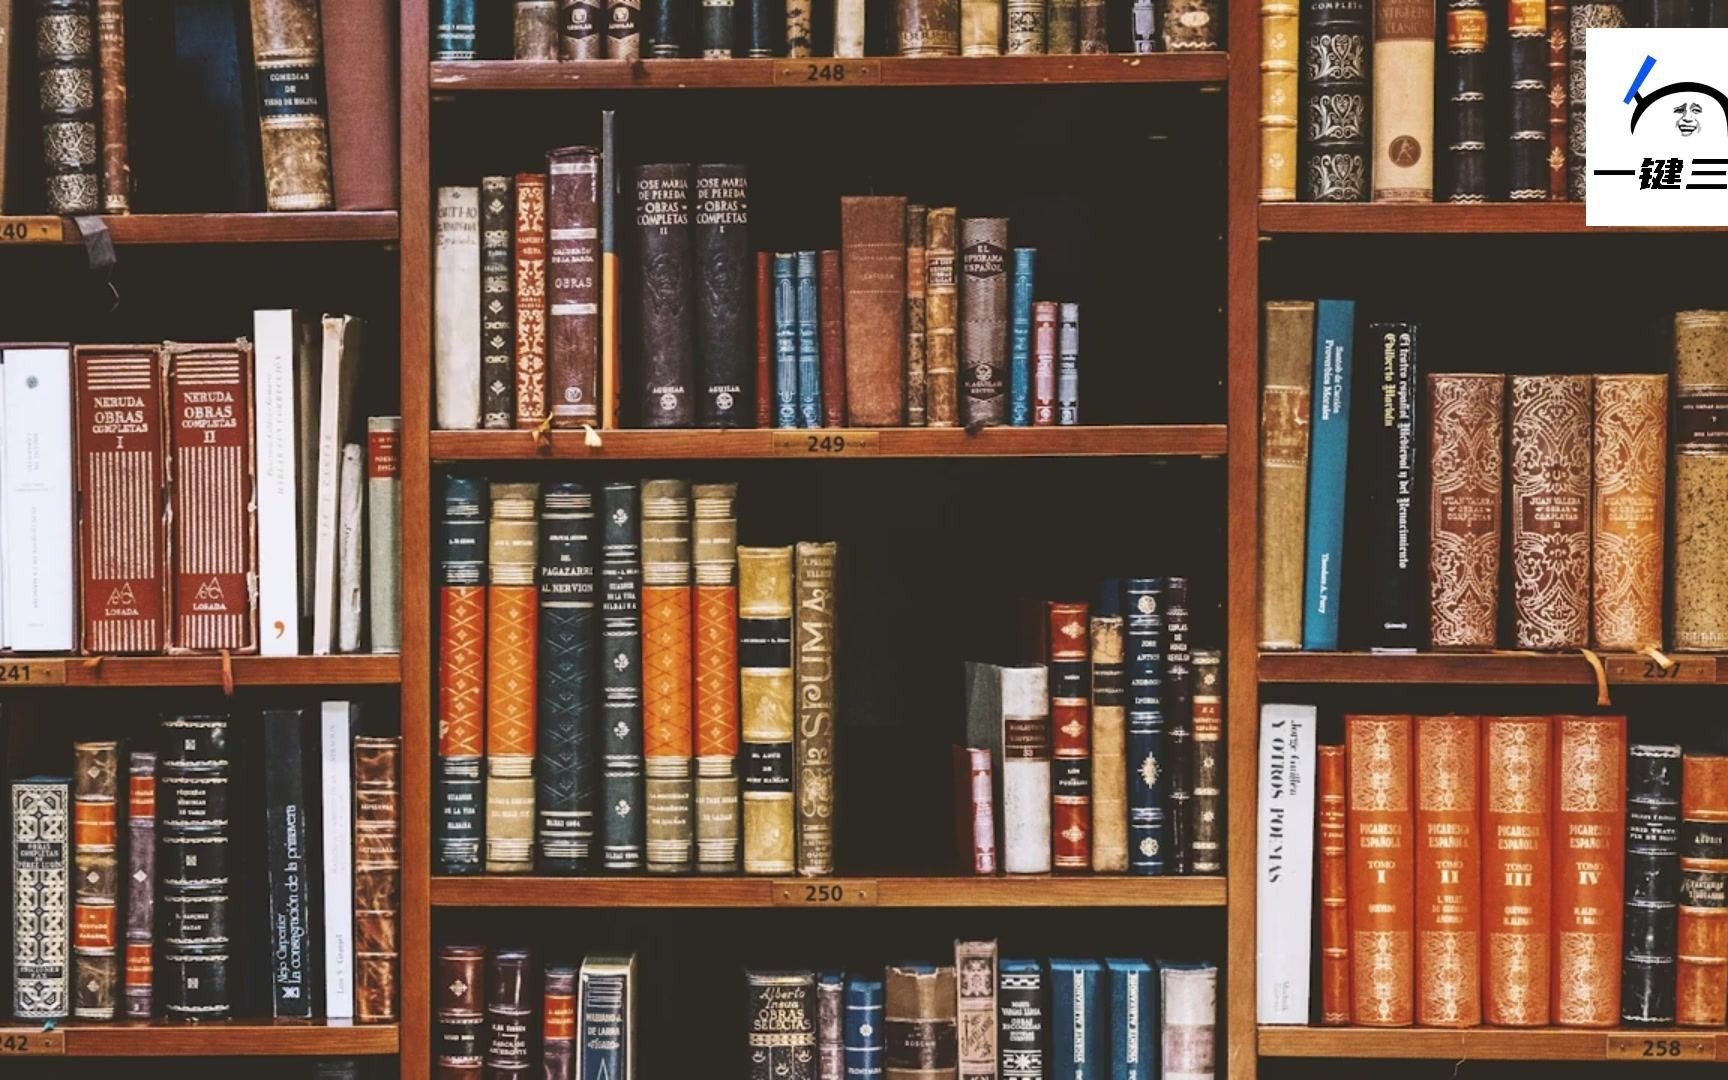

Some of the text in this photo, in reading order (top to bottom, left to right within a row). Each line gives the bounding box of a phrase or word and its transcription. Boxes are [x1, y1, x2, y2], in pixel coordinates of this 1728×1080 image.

[270, 74, 309, 82] COMEDIAS
[807, 64, 845, 81] 248
[285, 85, 296, 94] DE
[637, 179, 659, 191] JOSE
[696, 178, 719, 190] JOSE
[638, 190, 686, 201] DE PEREDA
[698, 188, 746, 200] DE PEREDA
[644, 201, 679, 214] OBRAS
[704, 200, 738, 213] OBRAS
[637, 213, 688, 226] COMPLETAS
[696, 212, 748, 225] COMPLETAS
[0, 221, 28, 241] 40
[977, 244, 989, 254] EL
[963, 262, 1003, 273] ESPAÑOL
[554, 276, 593, 289] OBRAS
[1398, 348, 1410, 379] teatro
[93, 396, 145, 409] NERUDA
[183, 390, 235, 404] NERUDA
[1321, 386, 1332, 421] Morales
[1397, 380, 1410, 419] español
[94, 410, 144, 424] OBRAS
[184, 405, 233, 419] OBRAS
[91, 422, 149, 435] COMPLETAS
[181, 418, 237, 429] COMPLETAS
[116, 435, 125, 450] I
[203, 430, 217, 444] II
[808, 436, 845, 453] 249
[1396, 421, 1411, 469] Medieval
[1398, 480, 1411, 495] del
[1529, 496, 1552, 506] JUAN
[1397, 496, 1410, 569] Renacimiento
[541, 566, 594, 577] PAGAZARRI
[541, 583, 594, 594] AL NERVION
[105, 607, 140, 617] LOSADA
[192, 602, 227, 612] LOSADA
[1288, 719, 1302, 752] Jorge
[1267, 719, 1285, 884] Y OTROS POEMAS
[1360, 823, 1402, 835] PICARESCA
[1427, 823, 1470, 835] PICARESCA
[1360, 835, 1401, 848] ESPAÑOLA
[1428, 836, 1468, 848] ESPAÑOLA
[1498, 837, 1539, 850] ESPAÑOLA
[1367, 860, 1396, 870] TOMO
[1434, 860, 1464, 870] TOMO
[1504, 862, 1533, 872] TOMO
[1575, 861, 1603, 871] TOMO
[1377, 869, 1387, 884] I
[1440, 869, 1460, 884] II
[1504, 871, 1533, 886] III
[1577, 871, 1602, 886] IV
[284, 804, 304, 984] La consagración de la primavera
[806, 885, 843, 903] 250
[276, 913, 289, 961] Carpentier
[758, 985, 806, 1001] Alberto
[758, 1007, 806, 1021] OBRAS
[753, 1019, 813, 1032] SELECTAS
[0, 1035, 28, 1052] 42
[1642, 1039, 1681, 1057] 258
